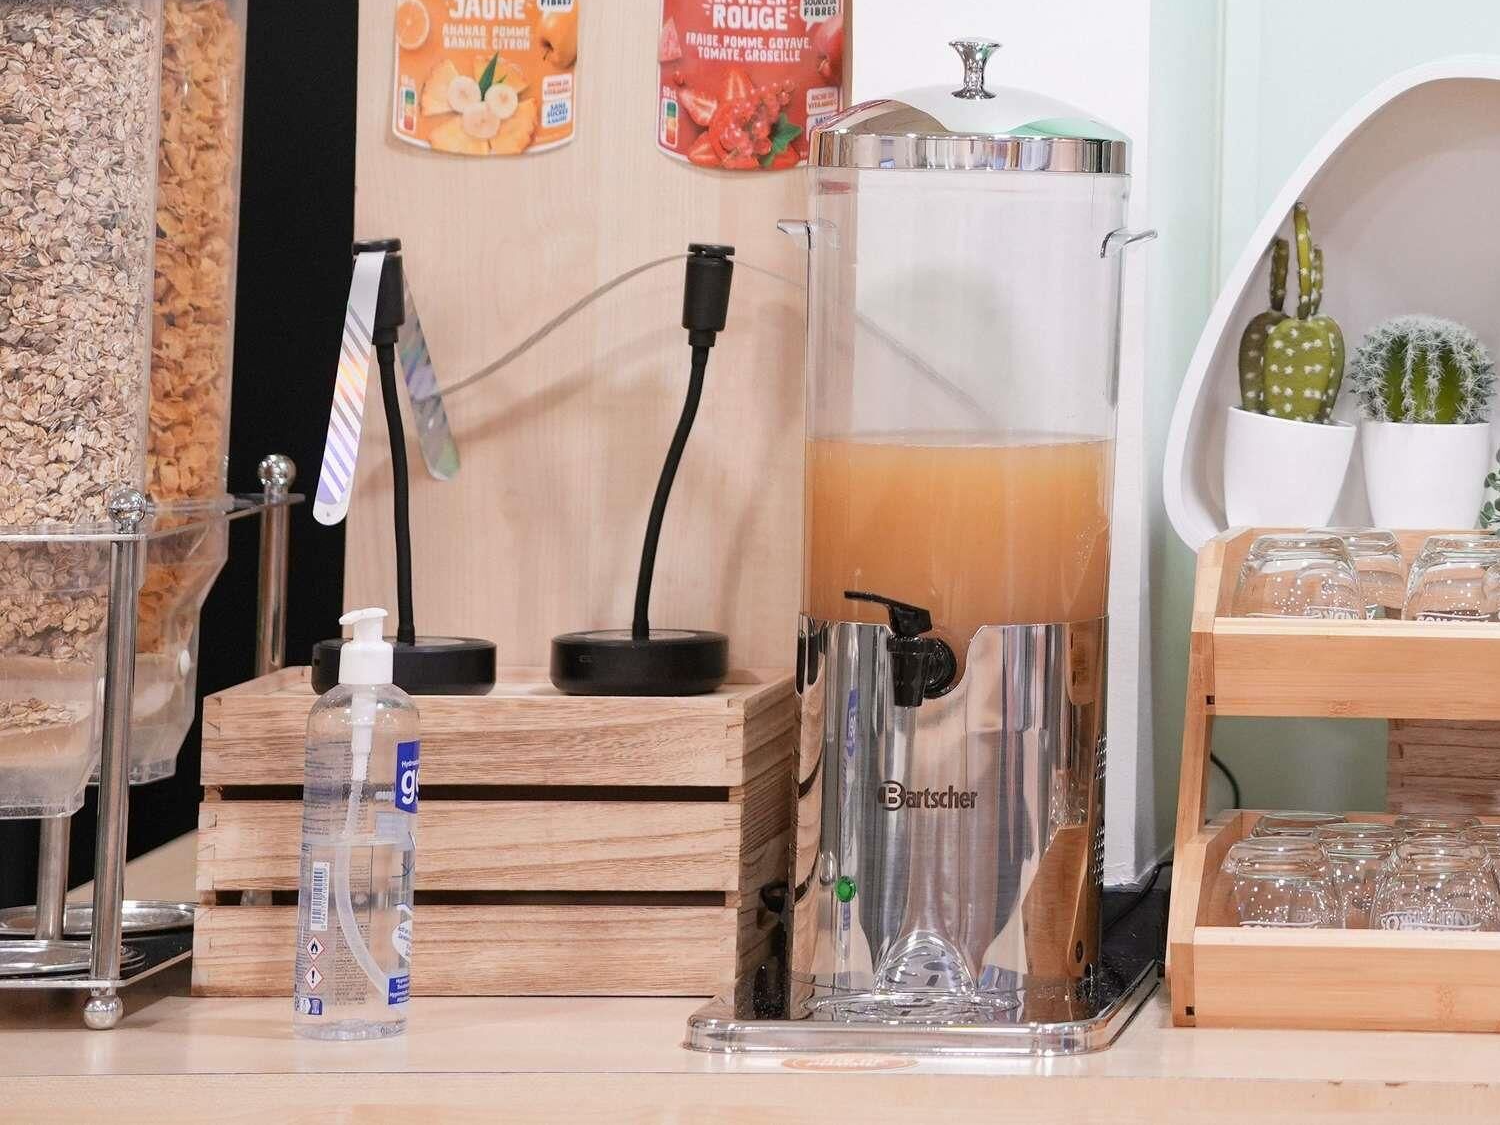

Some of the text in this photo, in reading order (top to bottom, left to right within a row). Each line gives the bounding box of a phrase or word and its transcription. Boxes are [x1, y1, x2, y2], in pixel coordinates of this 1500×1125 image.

[712, 4, 788, 31] ROUGE
[804, 5, 837, 16] FIBRES
[877, 780, 978, 811] Bartscher
